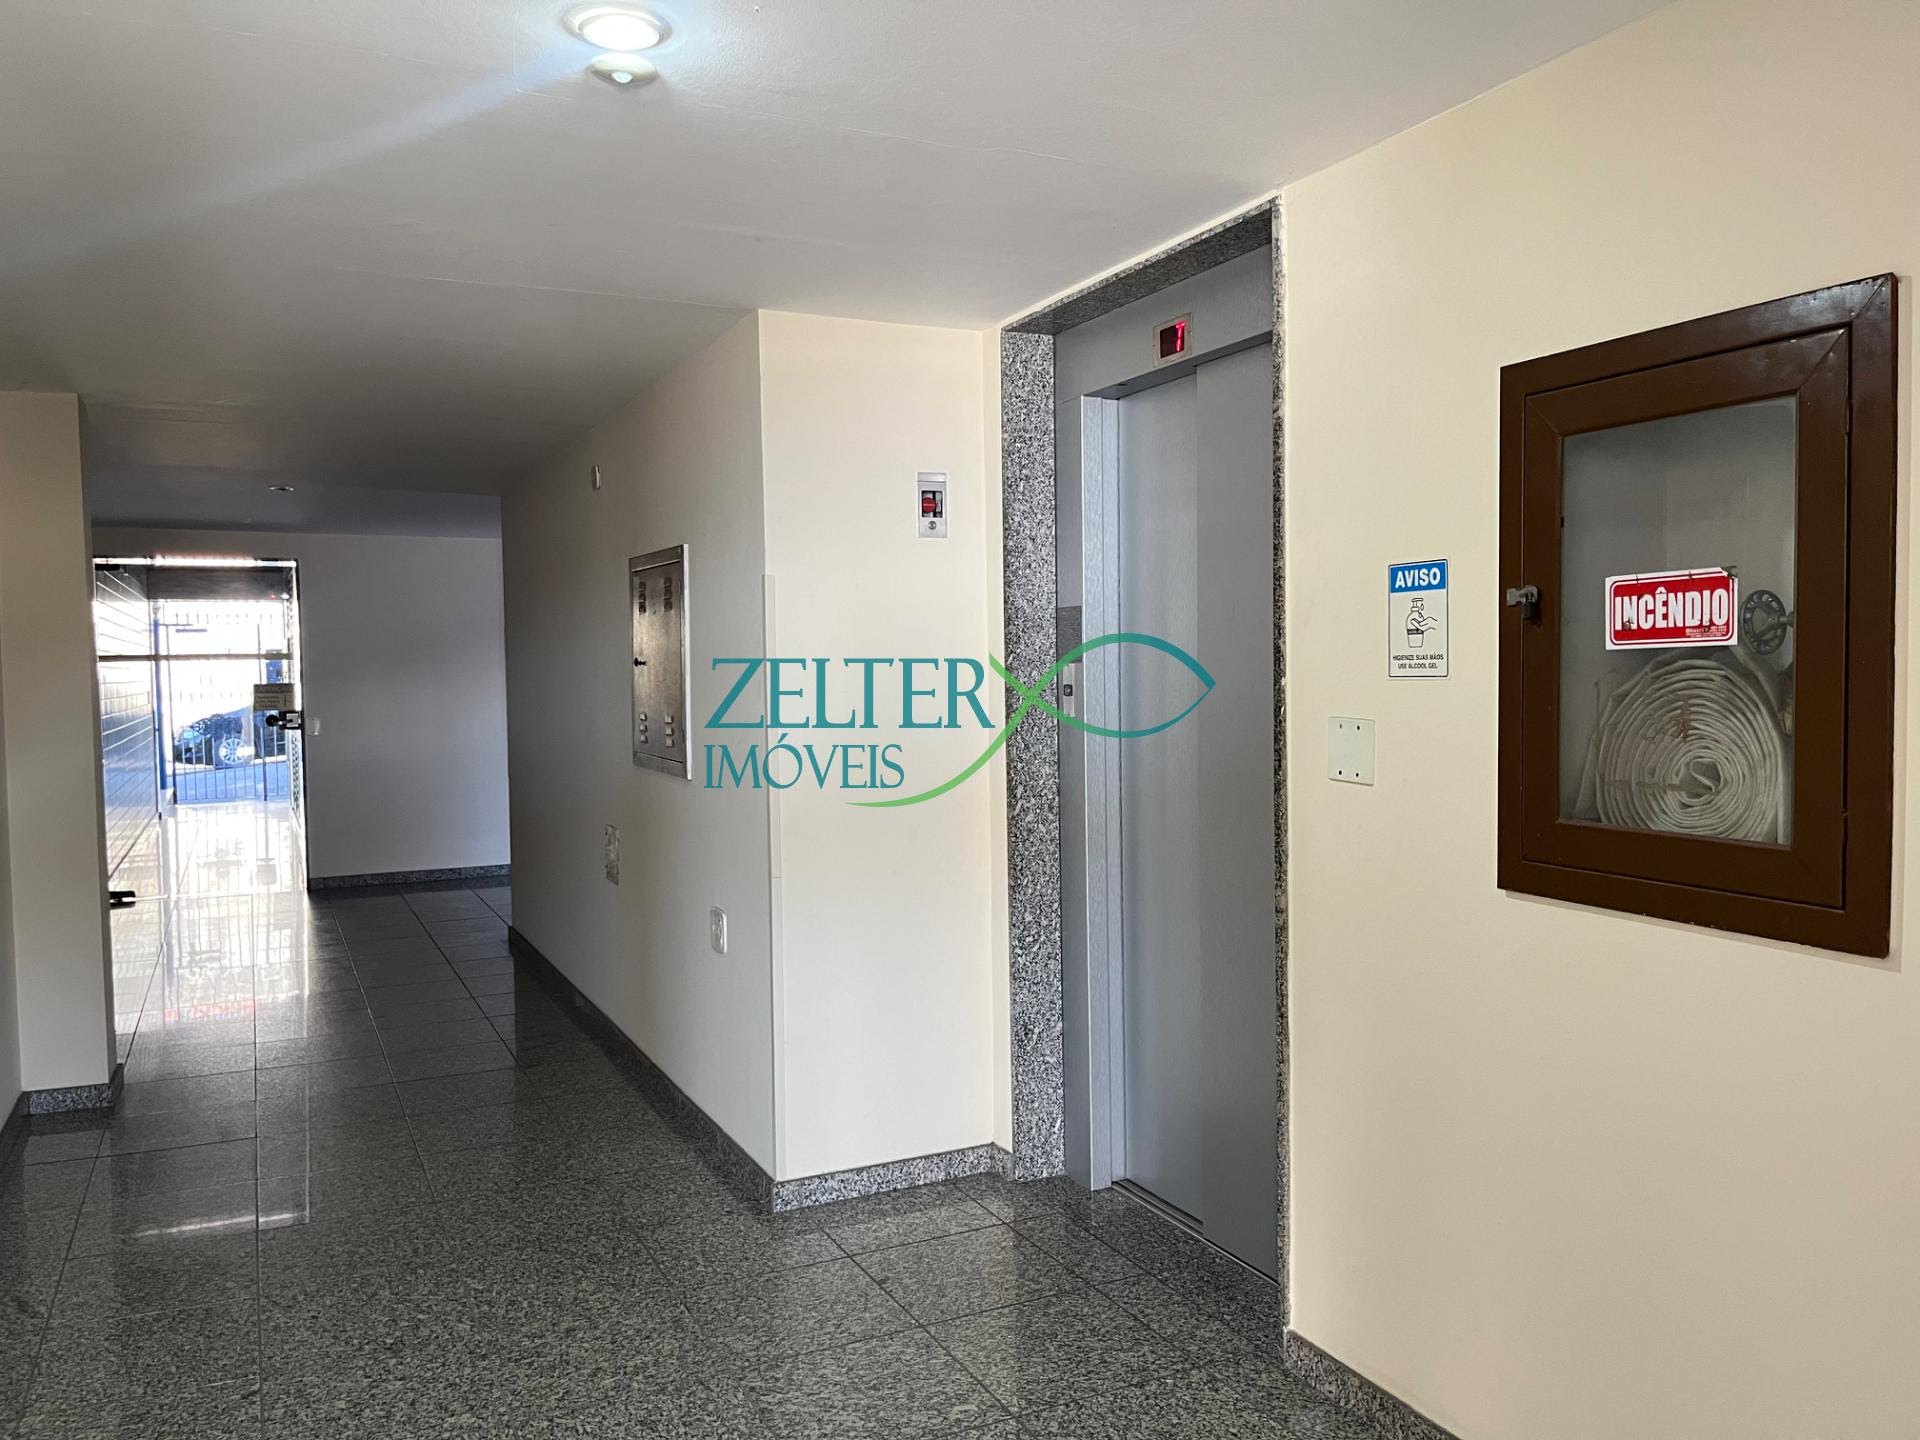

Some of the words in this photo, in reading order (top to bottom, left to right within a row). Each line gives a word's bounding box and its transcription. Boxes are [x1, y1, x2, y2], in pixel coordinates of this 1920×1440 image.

[1395, 567, 1441, 589] AVISO
[1615, 586, 1729, 631] INCÊNDIO
[1415, 653, 1429, 661] SUAS
